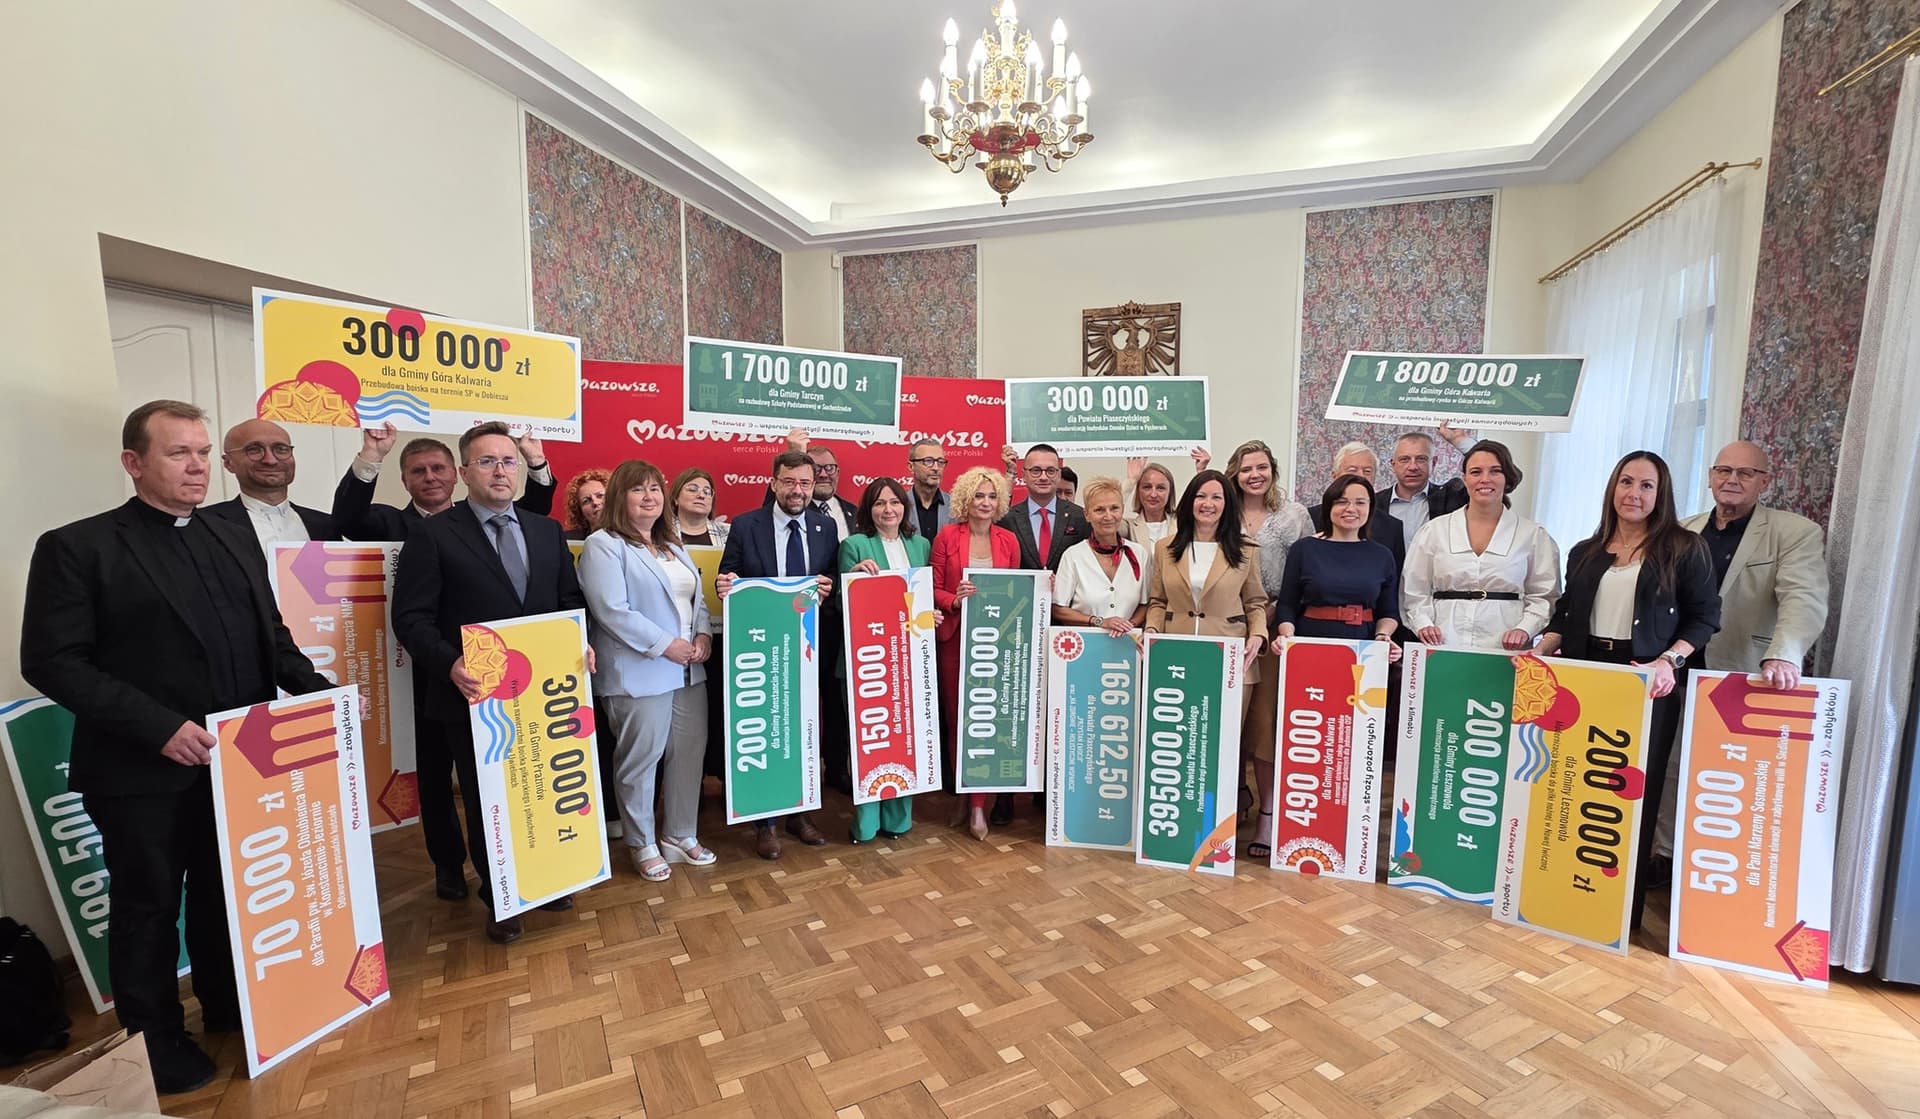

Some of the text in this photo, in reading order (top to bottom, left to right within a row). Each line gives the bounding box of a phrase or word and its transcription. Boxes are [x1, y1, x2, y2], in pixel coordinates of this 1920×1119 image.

[341, 315, 530, 376] 300 000 zł
[381, 365, 491, 387] dla Gminy Góra Kalwaria
[721, 351, 867, 392] 1 700 000 zł
[1371, 360, 1542, 387] 1 800 000 zł
[361, 378, 404, 390] Przebudowa
[406, 383, 428, 393] boiska
[768, 388, 823, 401] dla Gminy Tarczyn
[1046, 385, 1168, 411] 300 000 zł
[1419, 386, 1443, 395] Gminy
[1443, 387, 1461, 395] Góra
[1461, 388, 1491, 396] Kalwaria
[542, 425, 570, 435] sportu
[309, 614, 334, 632] zł
[340, 597, 353, 618] NMP
[342, 620, 357, 655] Poczęcia
[357, 650, 370, 685] Kalwarii
[770, 645, 781, 749] dla Gminy Konstancin-Jeziorna
[856, 621, 890, 755] 150 000 zł
[889, 635, 902, 733] dla Gminy Konstancin-Jeziorna
[920, 644, 930, 689] pożarnych
[967, 604, 999, 758] 1 000 000 zł
[1000, 682, 1011, 702] Gminy
[1002, 649, 1011, 680] Piaseczno
[339, 699, 355, 752] zabytków
[735, 626, 767, 774] 200 000 zł
[923, 691, 932, 719] straży
[1086, 706, 1095, 732] Powiatu
[1087, 694, 1095, 704] dla
[1406, 706, 1415, 734] klimatu
[528, 720, 546, 801] dla Gminy Prażmów
[541, 673, 589, 844] 300 000 zł
[1095, 659, 1130, 820] 166 612,50 zł
[1148, 664, 1188, 838] 395000,00 zł
[1185, 705, 1198, 799] dla Powiatu Piaseczyńskiego
[1285, 686, 1324, 827] 490 000 zł
[1322, 716, 1336, 800] dla Gminy Góra Kalwaria
[1441, 732, 1458, 810] dla Gminy Lesznowola
[1548, 759, 1558, 778] boiska
[1815, 691, 1838, 814] Mazowsze zabytków
[346, 773, 361, 830] Mazowsze
[1359, 722, 1377, 874] Mazowsze straży pożarnych
[1456, 698, 1504, 850] 200 000 zł
[1547, 778, 1556, 787] do
[1557, 755, 1576, 842] dla Gminy Lesznowola
[42, 791, 104, 865] 500
[1540, 827, 1551, 846] Nowej
[1572, 724, 1630, 893] 200 000 zł
[1688, 742, 1747, 896] 50 000 zł
[1746, 759, 1771, 886] dla Pani Marzeny Sosnowskiej
[239, 788, 303, 983] 70 000 zł
[290, 767, 324, 968] dla Parafii pw. św. Józefa Oblubieńca NMP
[308, 799, 333, 918] w Konstancinie-Jeziornie
[490, 804, 510, 907] Mazowsze sportu
[1500, 817, 1518, 911] Mazowsze sportu
[1764, 901, 1776, 927] Remont
